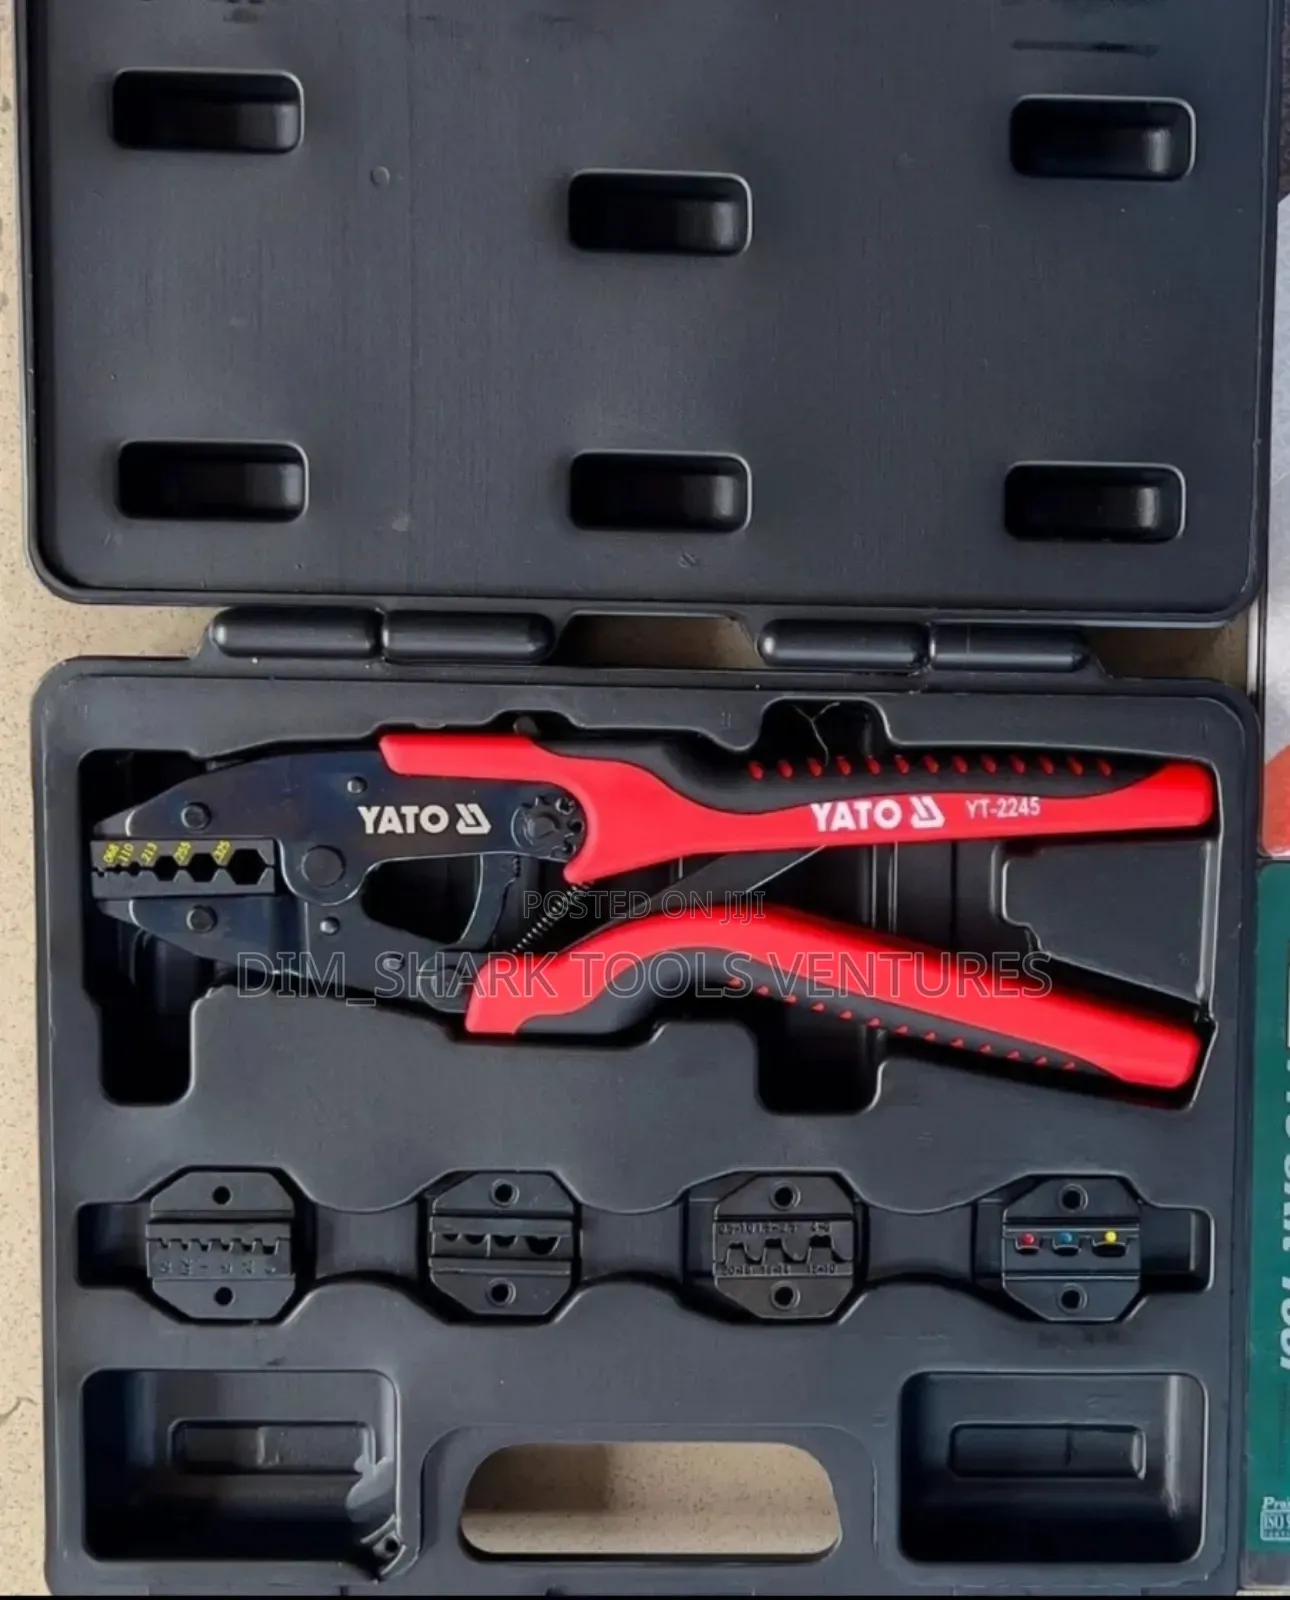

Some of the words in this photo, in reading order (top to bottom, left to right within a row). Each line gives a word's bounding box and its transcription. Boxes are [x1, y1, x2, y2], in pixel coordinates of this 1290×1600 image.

[358, 805, 450, 835] YATO
[811, 799, 903, 832] YATO
[966, 796, 1041, 820] YT-2245
